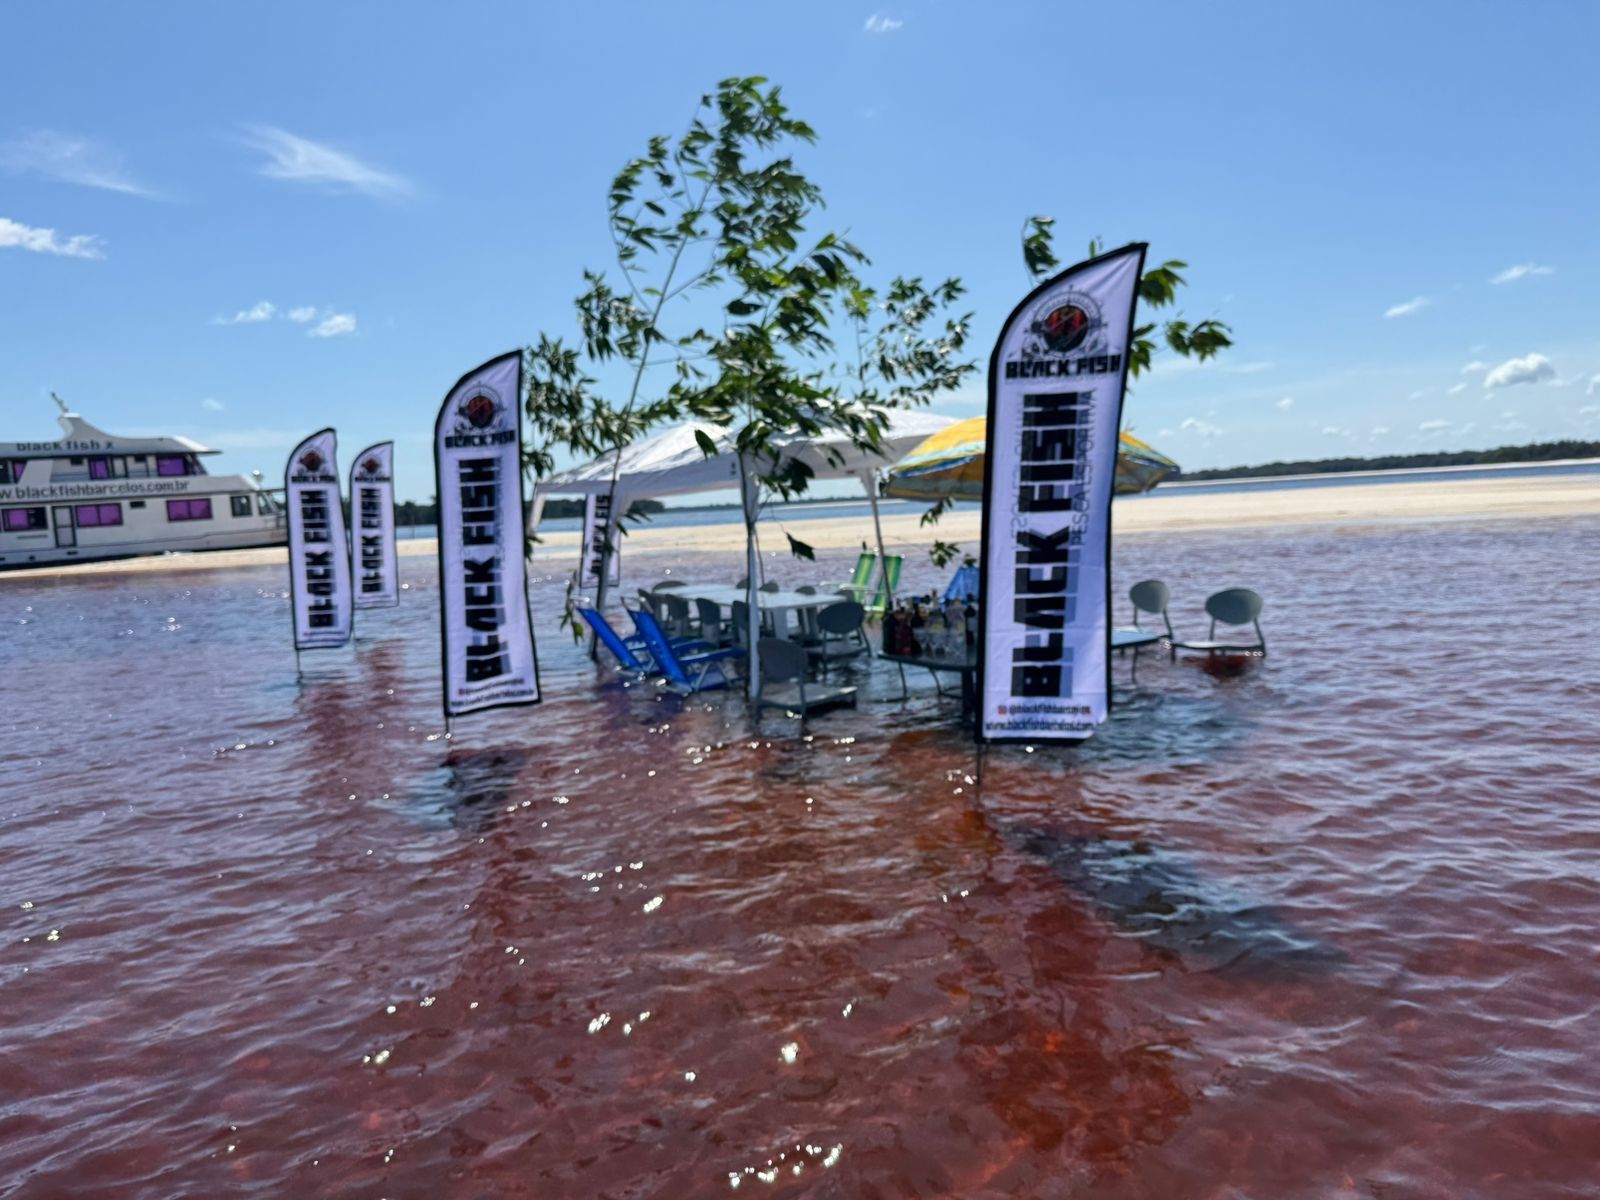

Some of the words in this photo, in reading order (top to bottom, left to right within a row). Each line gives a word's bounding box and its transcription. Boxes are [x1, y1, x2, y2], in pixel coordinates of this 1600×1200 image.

[1005, 360, 1070, 379] BLACK
[1076, 354, 1122, 375] FISH
[17, 441, 63, 451] black
[67, 440, 100, 450] fish
[1018, 391, 1078, 513] FISH
[458, 458, 497, 546] FISH
[464, 556, 503, 682] BLACK
[1010, 525, 1072, 697] BLACK
